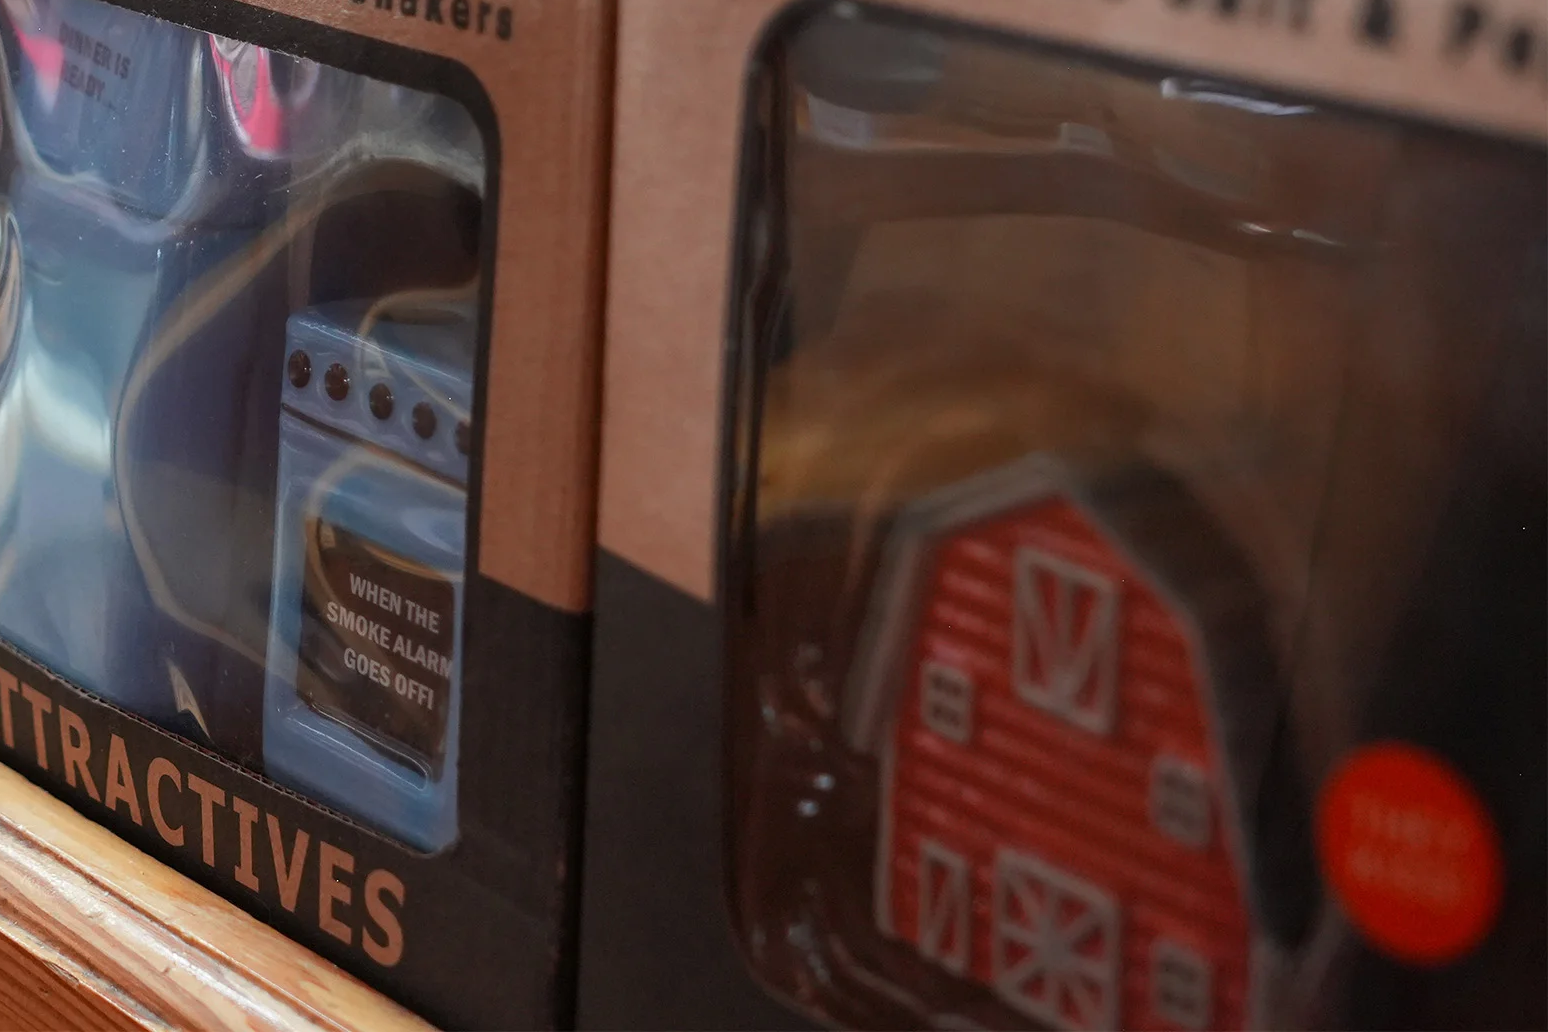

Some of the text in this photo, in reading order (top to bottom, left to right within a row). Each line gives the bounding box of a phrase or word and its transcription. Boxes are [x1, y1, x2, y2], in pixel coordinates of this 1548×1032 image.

[114, 52, 131, 80] IS
[350, 572, 440, 634] WHEN THE
[326, 600, 453, 679] SMOKE ALARM
[343, 647, 391, 688] GOES
